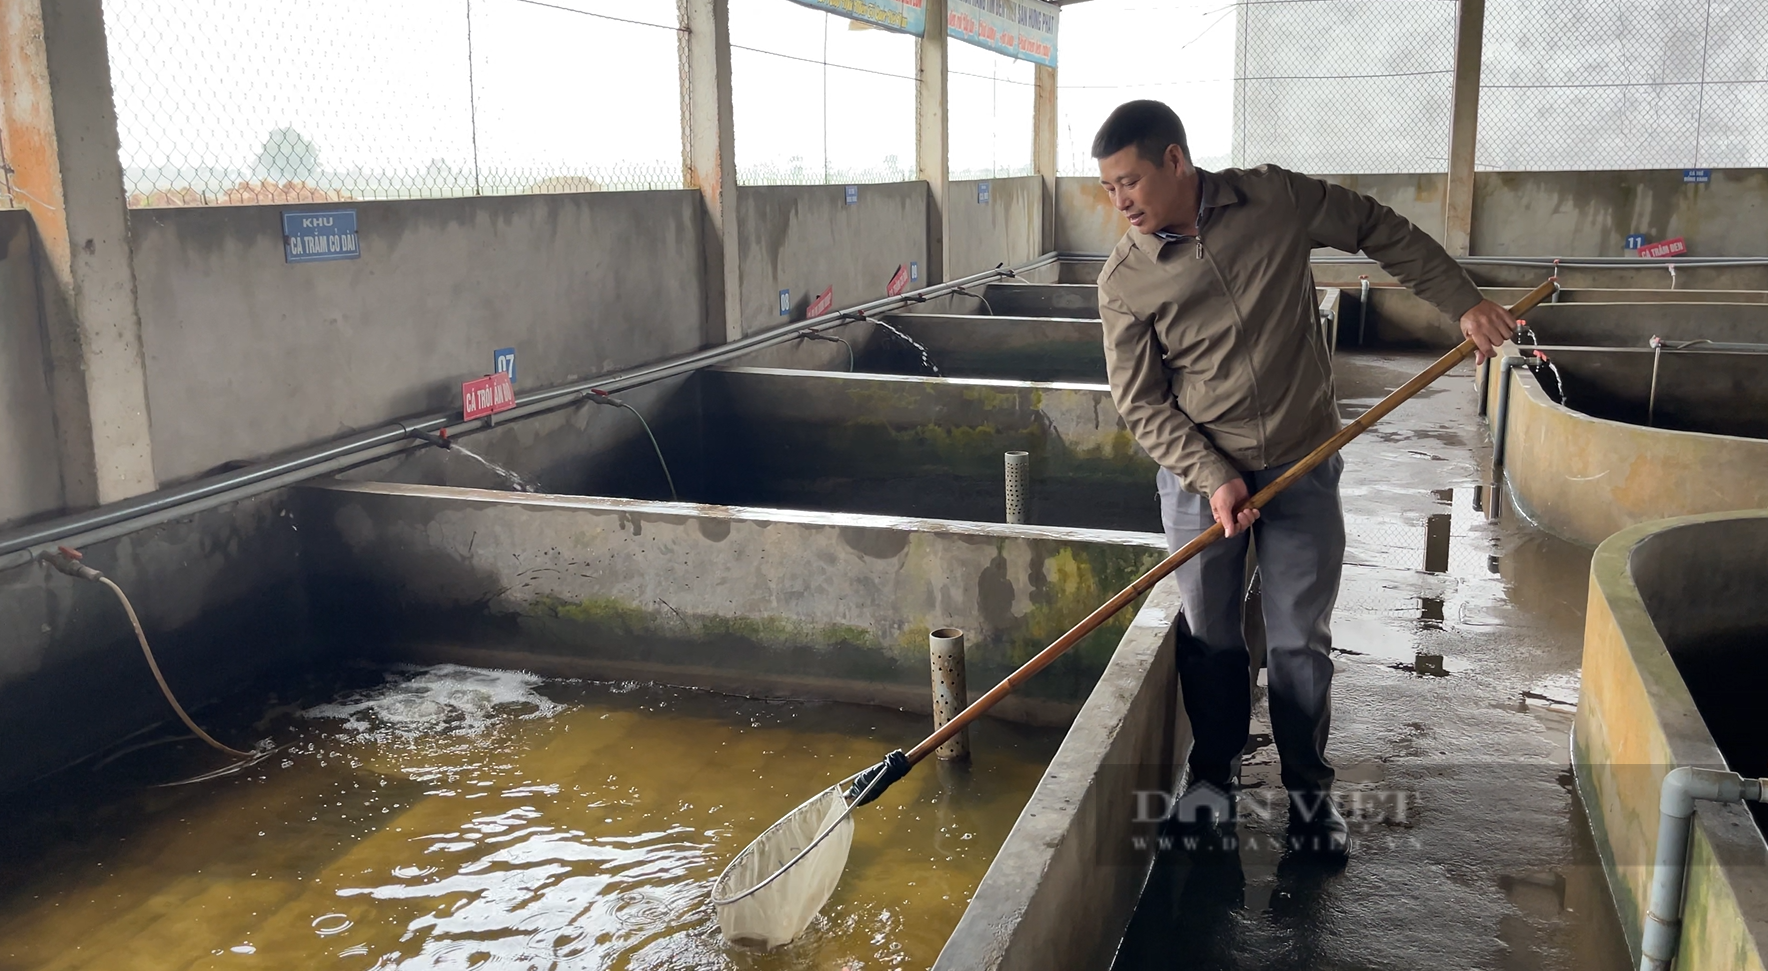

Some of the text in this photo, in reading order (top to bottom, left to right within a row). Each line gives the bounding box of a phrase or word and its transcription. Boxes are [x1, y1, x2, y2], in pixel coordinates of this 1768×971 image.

[302, 216, 334, 228] KHU
[290, 227, 356, 255] CÁ TRẮM CỎ DÀI
[1628, 236, 1642, 249] 11
[497, 353, 515, 379] 07
[466, 387, 477, 413] CÁ
